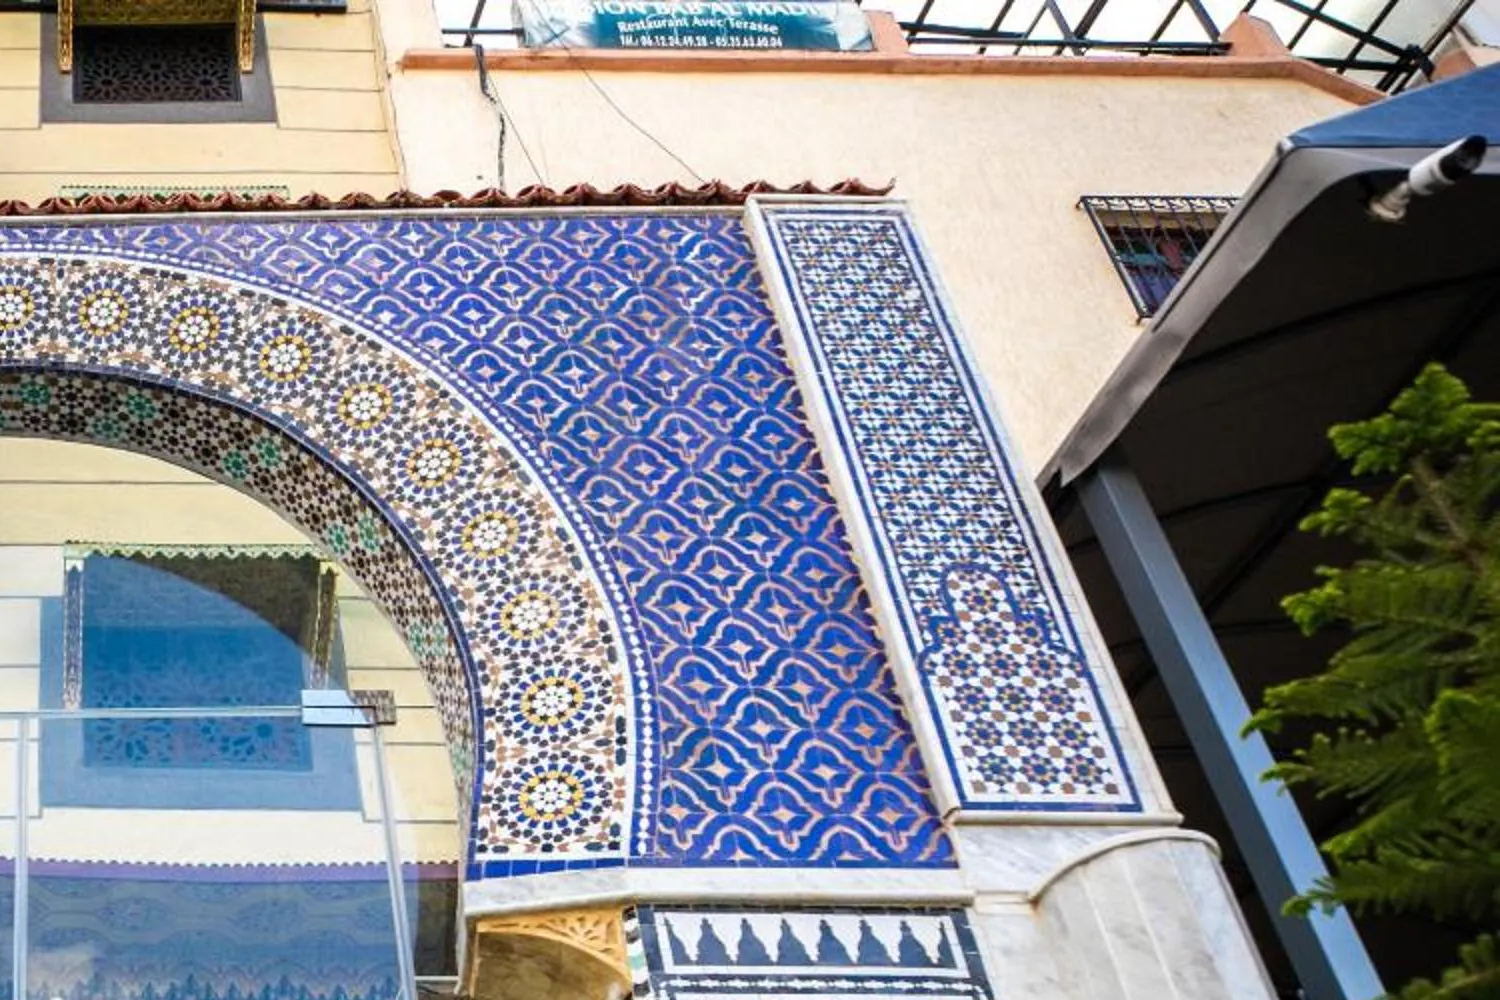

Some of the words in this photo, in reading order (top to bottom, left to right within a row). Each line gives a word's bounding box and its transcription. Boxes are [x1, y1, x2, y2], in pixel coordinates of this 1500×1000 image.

[617, 18, 690, 32] Restaurant
[691, 16, 725, 28] Avec
[728, 18, 779, 34] Terasse
